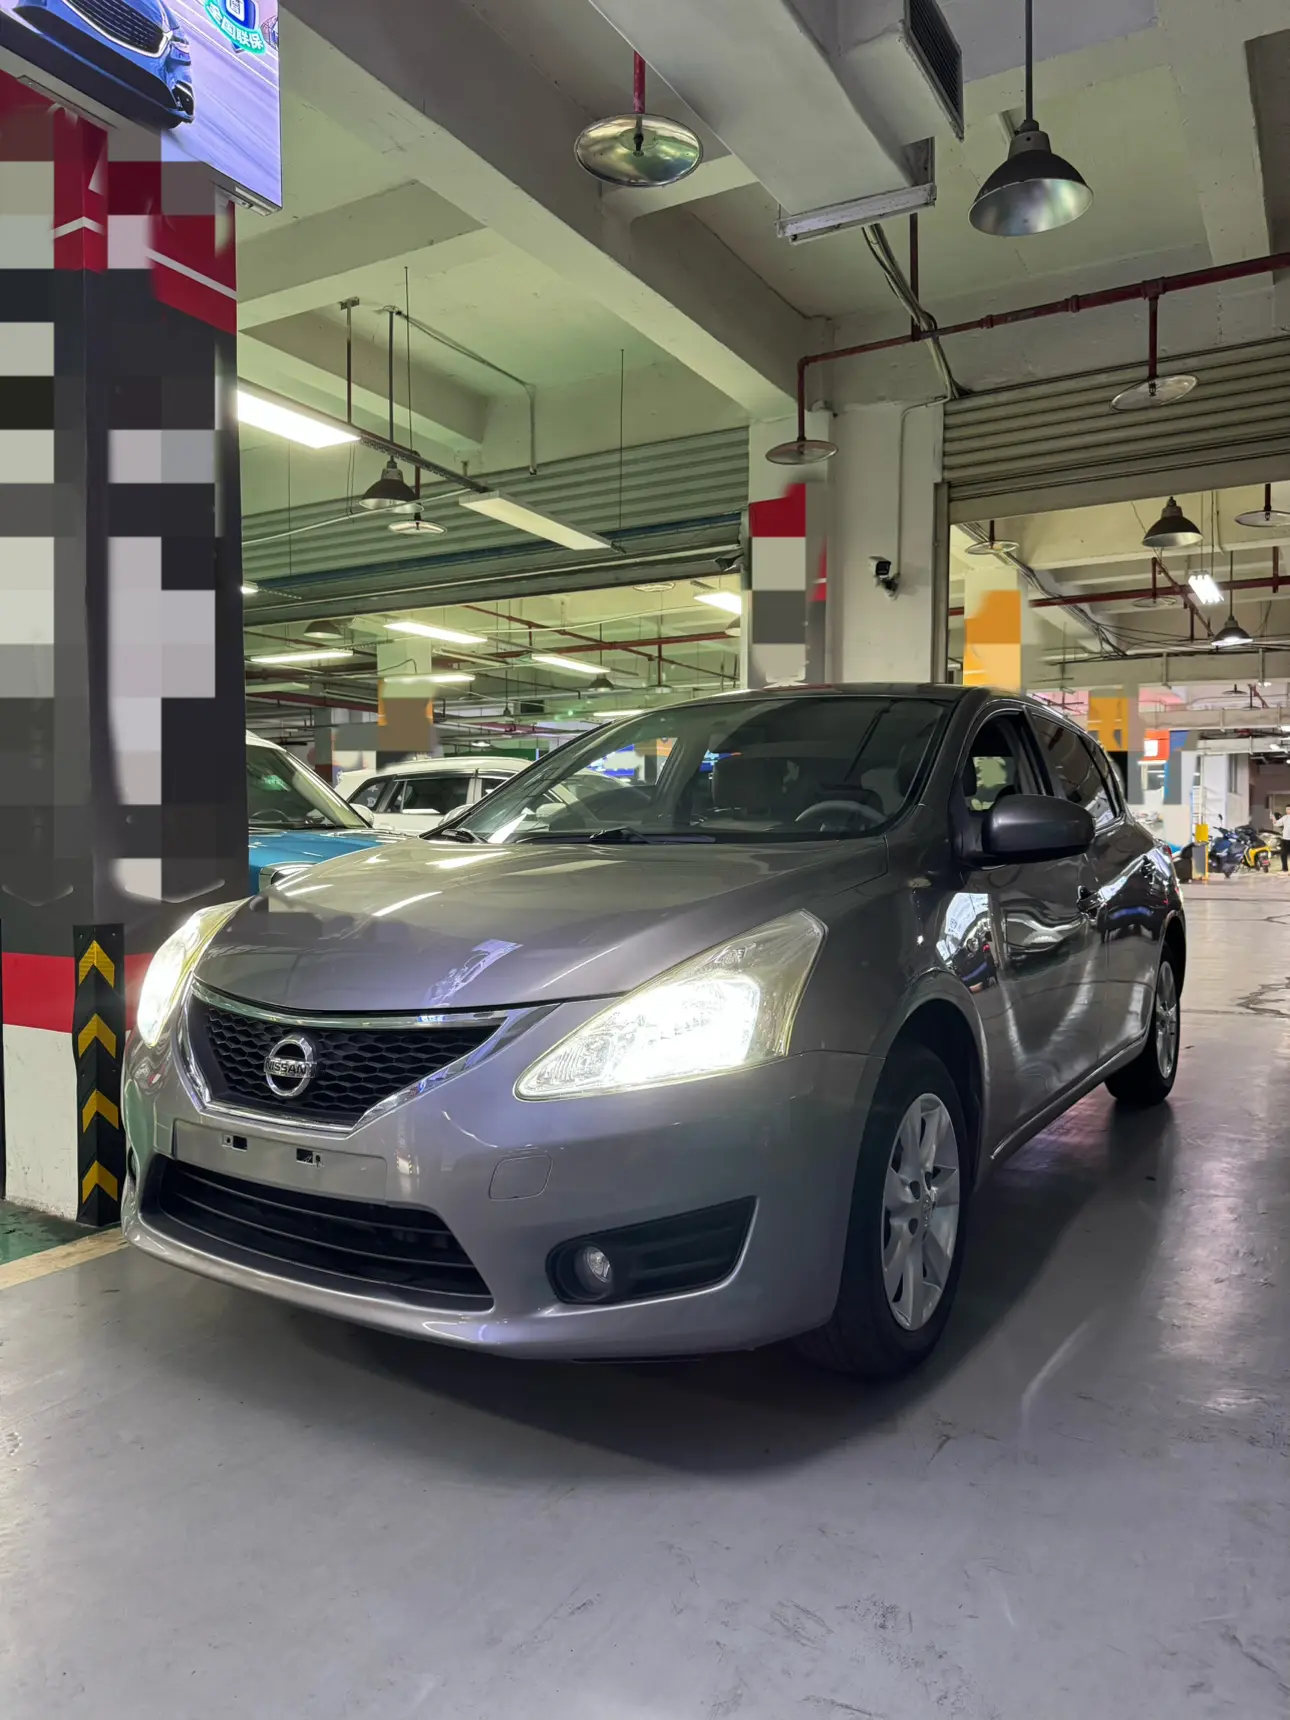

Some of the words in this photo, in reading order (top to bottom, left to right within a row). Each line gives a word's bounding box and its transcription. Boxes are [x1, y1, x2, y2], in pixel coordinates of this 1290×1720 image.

[206, 2, 264, 50] 全国联保
[265, 1059, 307, 1075] NISSAN
